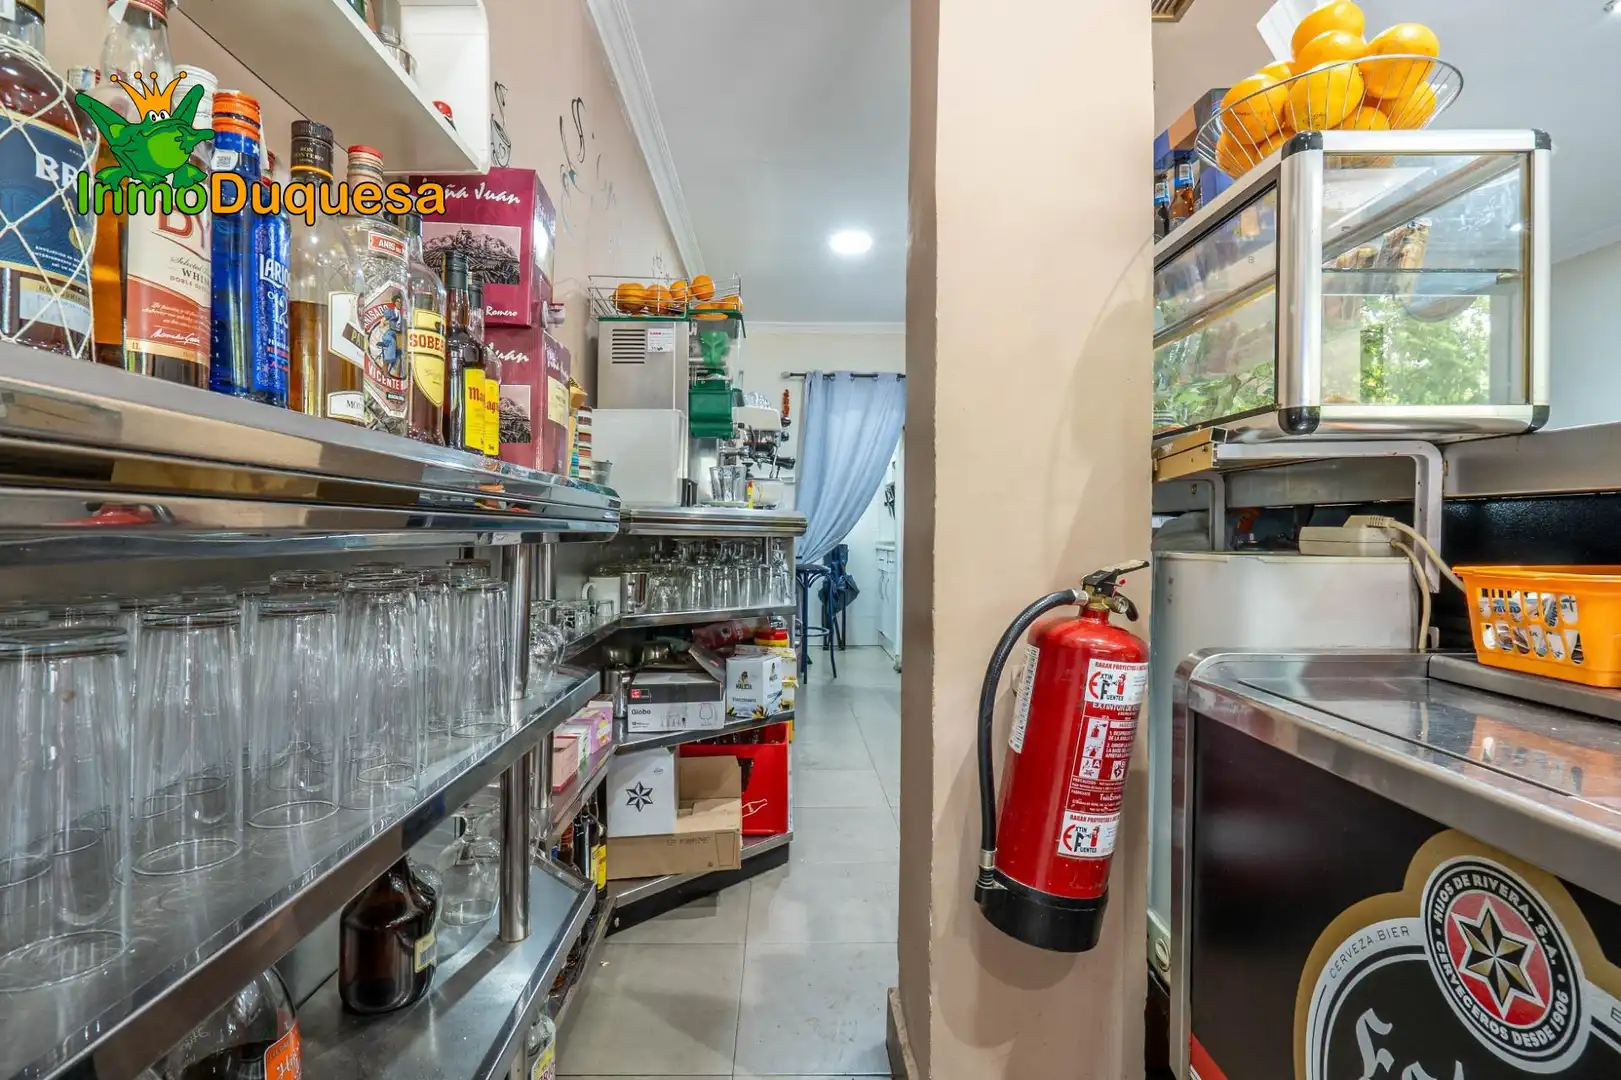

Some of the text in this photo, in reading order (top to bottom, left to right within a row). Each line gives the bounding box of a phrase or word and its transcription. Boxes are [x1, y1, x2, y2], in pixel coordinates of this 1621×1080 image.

[475, 181, 521, 205] Juan
[378, 239, 396, 250] ANIS
[1433, 874, 1558, 965] HIJOS DE RIVERA, S.A.
[1329, 925, 1411, 979] CERVEZA BIER
[1436, 941, 1509, 1040] CERVECEROS
[1511, 1025, 1556, 1047] DESDE
[1551, 989, 1569, 1031] 1906
